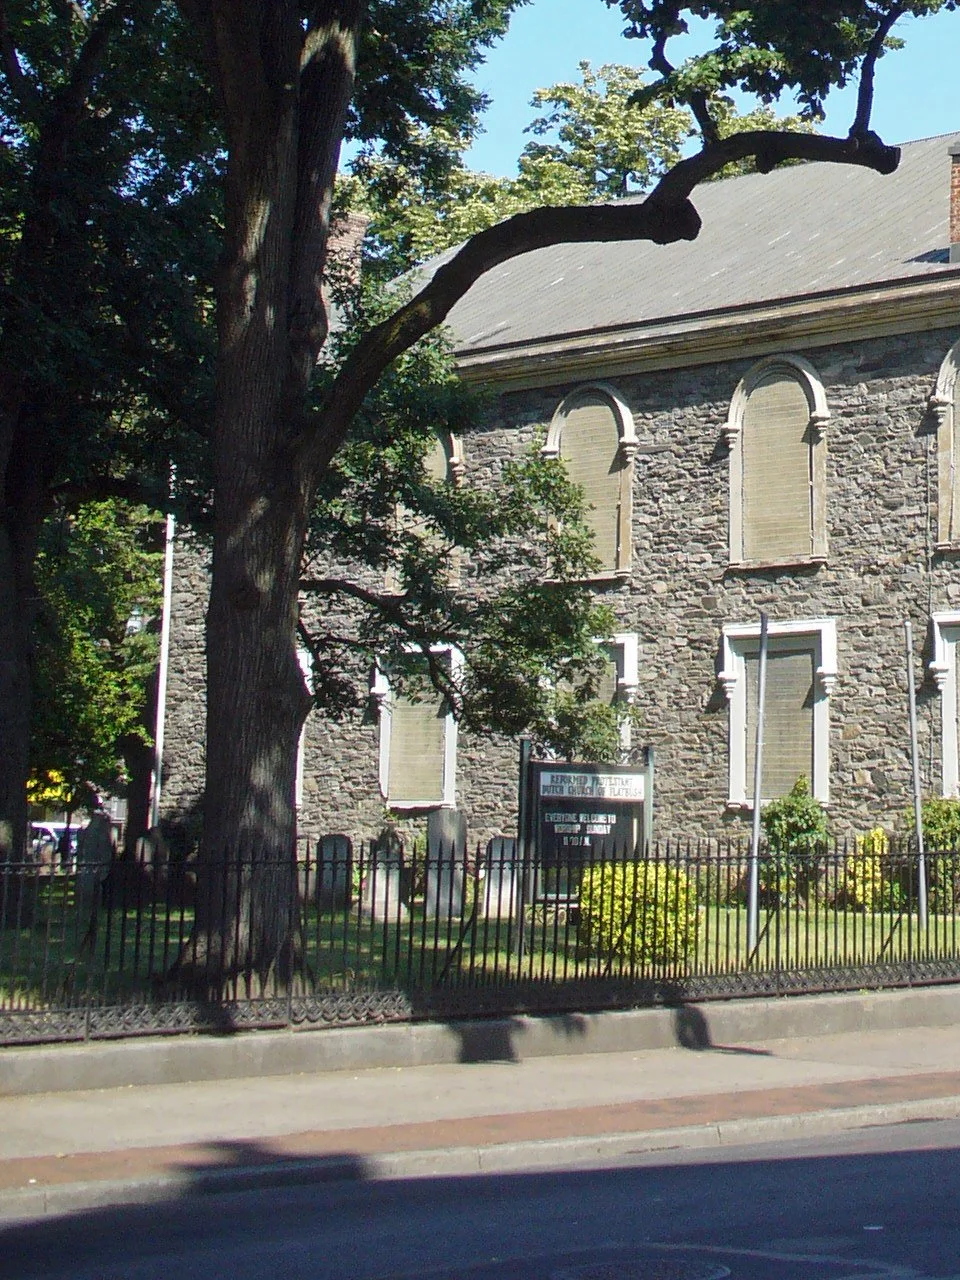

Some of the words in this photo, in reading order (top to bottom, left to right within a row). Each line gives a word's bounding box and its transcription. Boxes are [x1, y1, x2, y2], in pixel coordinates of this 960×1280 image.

[550, 774, 588, 785] REFORMED
[592, 776, 633, 786] PROTESTANT
[542, 785, 564, 795] DUTCH
[568, 785, 595, 796] CHURCH
[598, 787, 606, 796] OF
[545, 813, 577, 822] EVERYONE
[579, 814, 607, 823] WELCOME
[607, 814, 616, 824] TO
[554, 824, 581, 833] WORSHIP
[586, 824, 611, 834] SUNDAY
